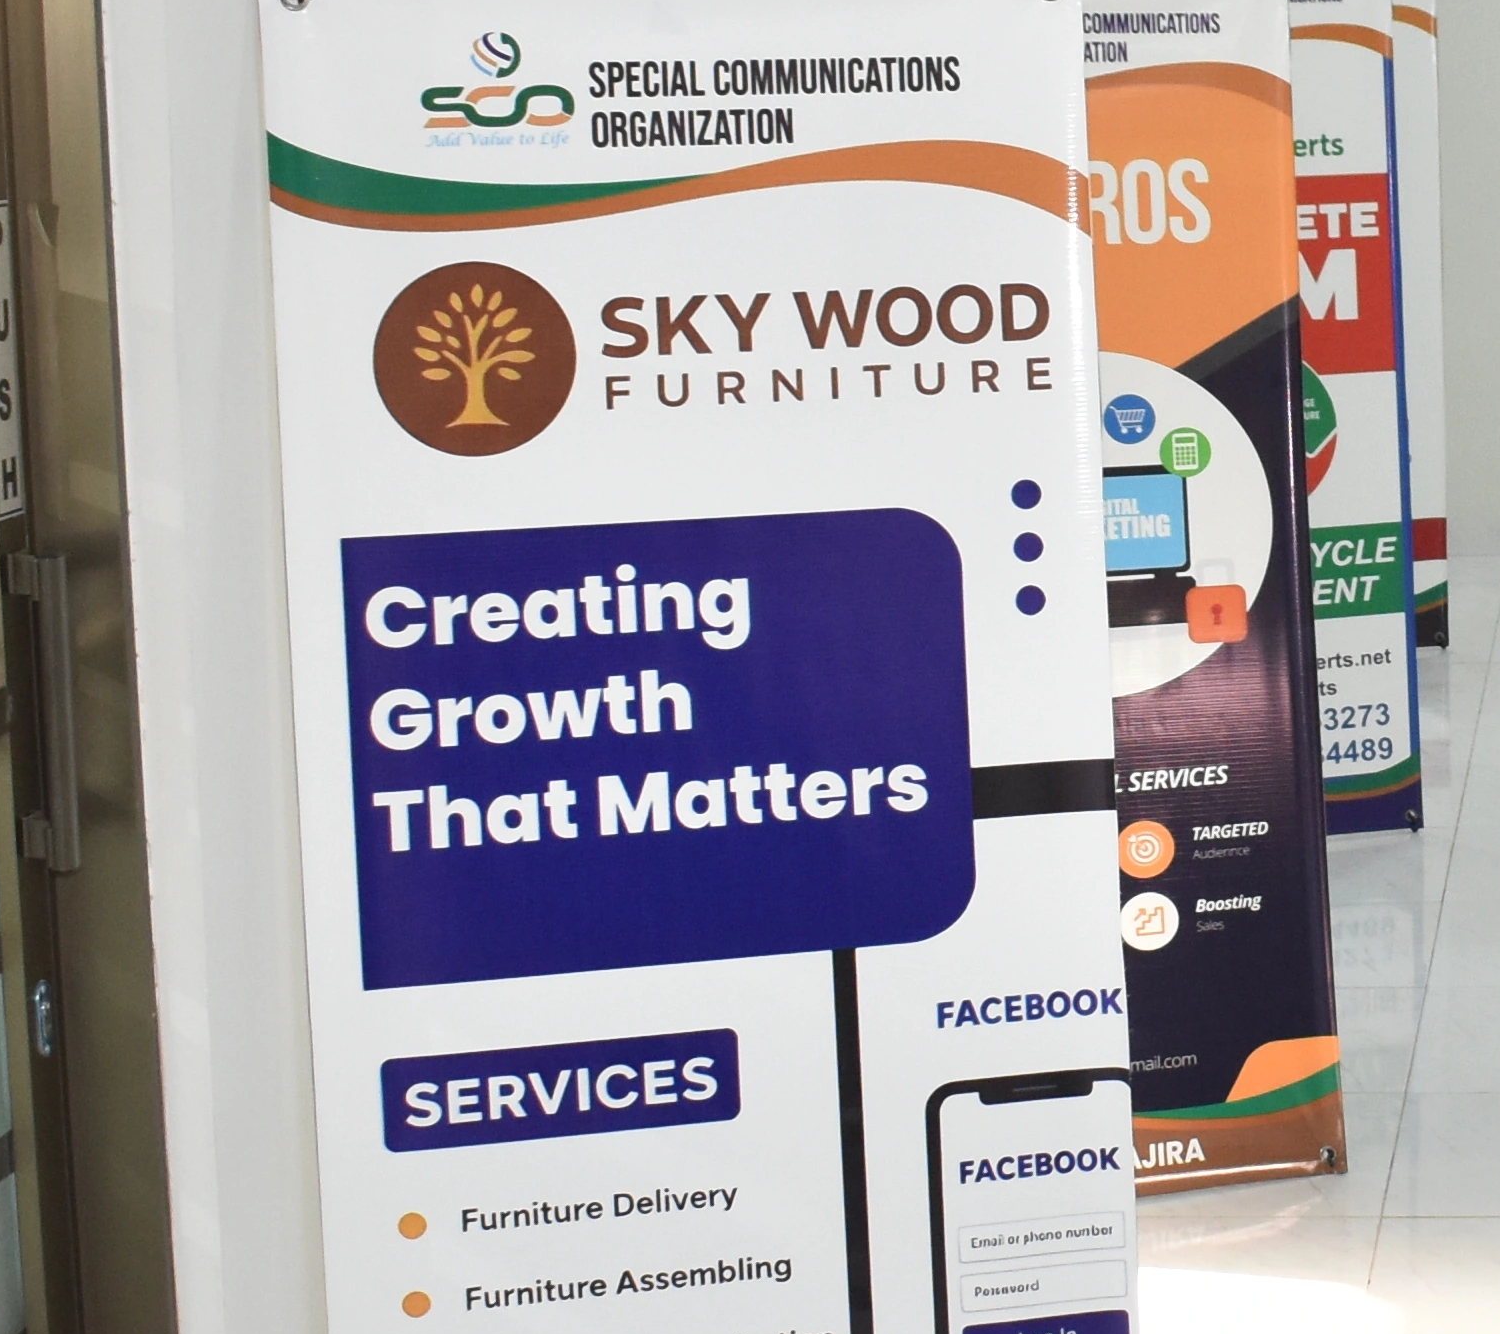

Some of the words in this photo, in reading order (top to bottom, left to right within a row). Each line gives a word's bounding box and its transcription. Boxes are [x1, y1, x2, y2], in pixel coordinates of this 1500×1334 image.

[1082, 12, 1221, 34] COMMUNICATIONS
[589, 60, 706, 99] SPECIAL
[713, 56, 961, 97] COMMUNICATIONS
[426, 132, 462, 148] Add
[468, 131, 514, 147] Value
[519, 132, 535, 145] to
[591, 107, 795, 149] ORGANIZATION
[1088, 158, 1211, 245] ROS
[1296, 202, 1380, 240] ETE
[600, 292, 771, 359] SKY
[794, 282, 1051, 350] WOOD
[605, 357, 1053, 410] FURNITURE
[365, 564, 751, 650] Creating
[370, 669, 693, 751] Growth
[1322, 737, 1393, 764] 4489
[1128, 765, 1229, 792] SERVICES
[372, 779, 579, 852] That
[598, 763, 928, 838] Matters
[1192, 821, 1269, 841] TARGETED
[1195, 894, 1262, 913] Boosting
[936, 987, 1124, 1028] FACEBOOK
[1130, 1053, 1198, 1073] mail.com
[405, 1056, 719, 1127] SERVICES
[958, 1146, 1120, 1185] FACEBOOK
[460, 1198, 604, 1234] Furniture
[612, 1184, 738, 1218] Delivery
[1008, 1237, 1020, 1245] or
[465, 1274, 608, 1312] Furniture
[616, 1255, 793, 1295] Assembling
